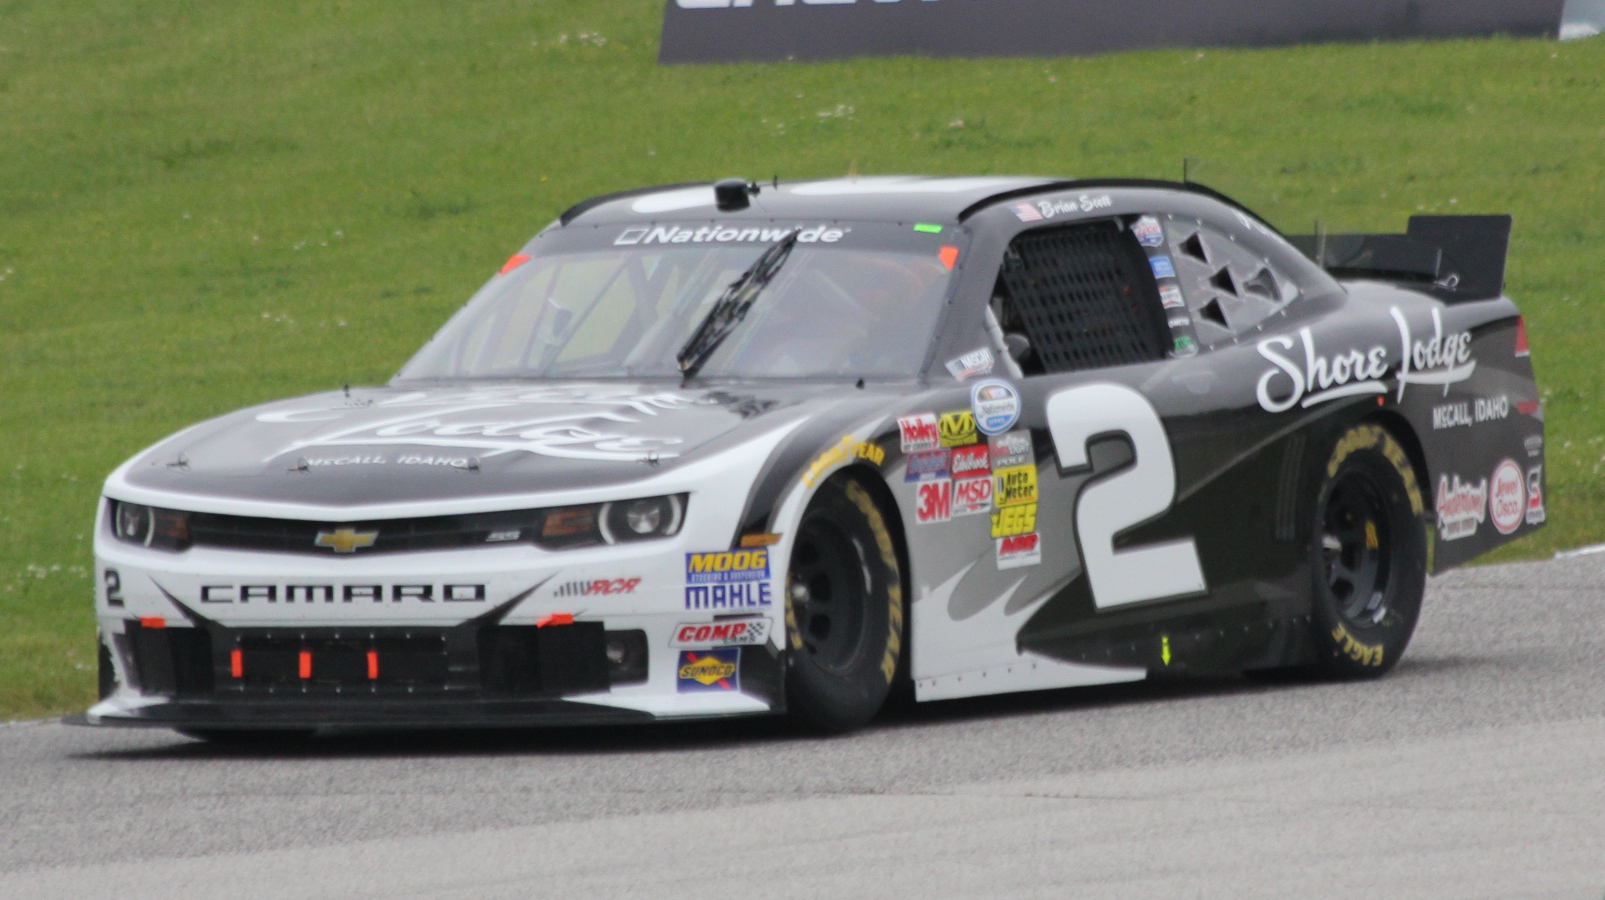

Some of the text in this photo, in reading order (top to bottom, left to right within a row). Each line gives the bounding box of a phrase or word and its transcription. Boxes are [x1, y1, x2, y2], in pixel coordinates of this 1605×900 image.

[1037, 195, 1113, 218] Brian Scott
[643, 224, 843, 245] Nationwde
[1256, 306, 1476, 413] Shore Lodge
[1474, 396, 1509, 422] IDAHO
[902, 417, 939, 447] Holley
[1006, 484, 1035, 499] Meter
[1007, 471, 1029, 486] Auto
[918, 481, 950, 522] 3M
[955, 479, 992, 505] MSD
[1047, 383, 1207, 608] 2
[990, 503, 1036, 538] JEGS
[689, 551, 767, 573] MOOG
[105, 568, 125, 607] 2
[201, 584, 486, 603] CAMARO
[685, 582, 772, 609] MAHLE
[678, 622, 747, 642] COMP
[679, 664, 735, 679] SUNOCO
